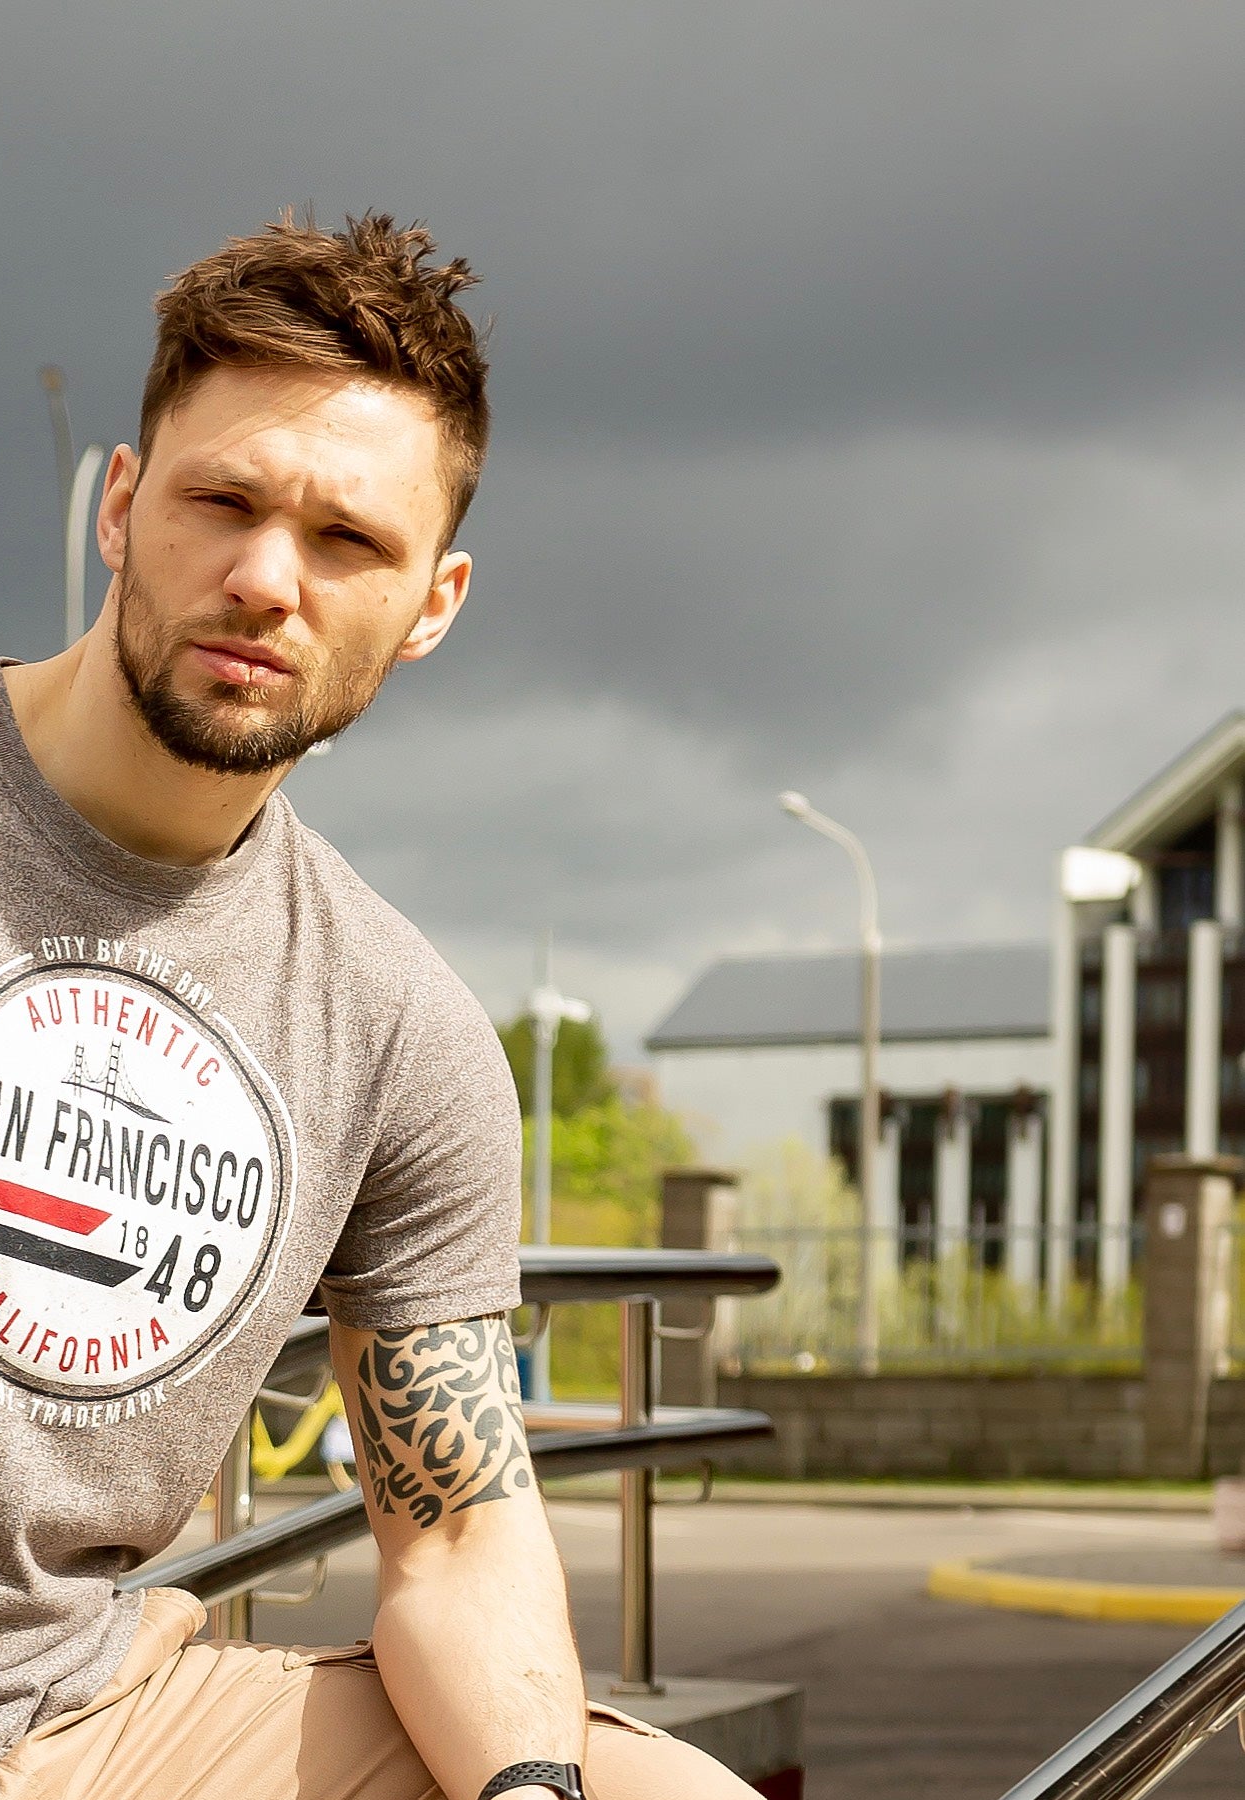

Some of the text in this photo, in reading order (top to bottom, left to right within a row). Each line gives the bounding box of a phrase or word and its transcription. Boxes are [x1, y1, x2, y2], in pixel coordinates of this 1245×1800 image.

[41, 935, 214, 1011] CITY BY THE BAY
[26, 987, 221, 1088] AUTHENTIC
[45, 1099, 264, 1229] FRANCISCO
